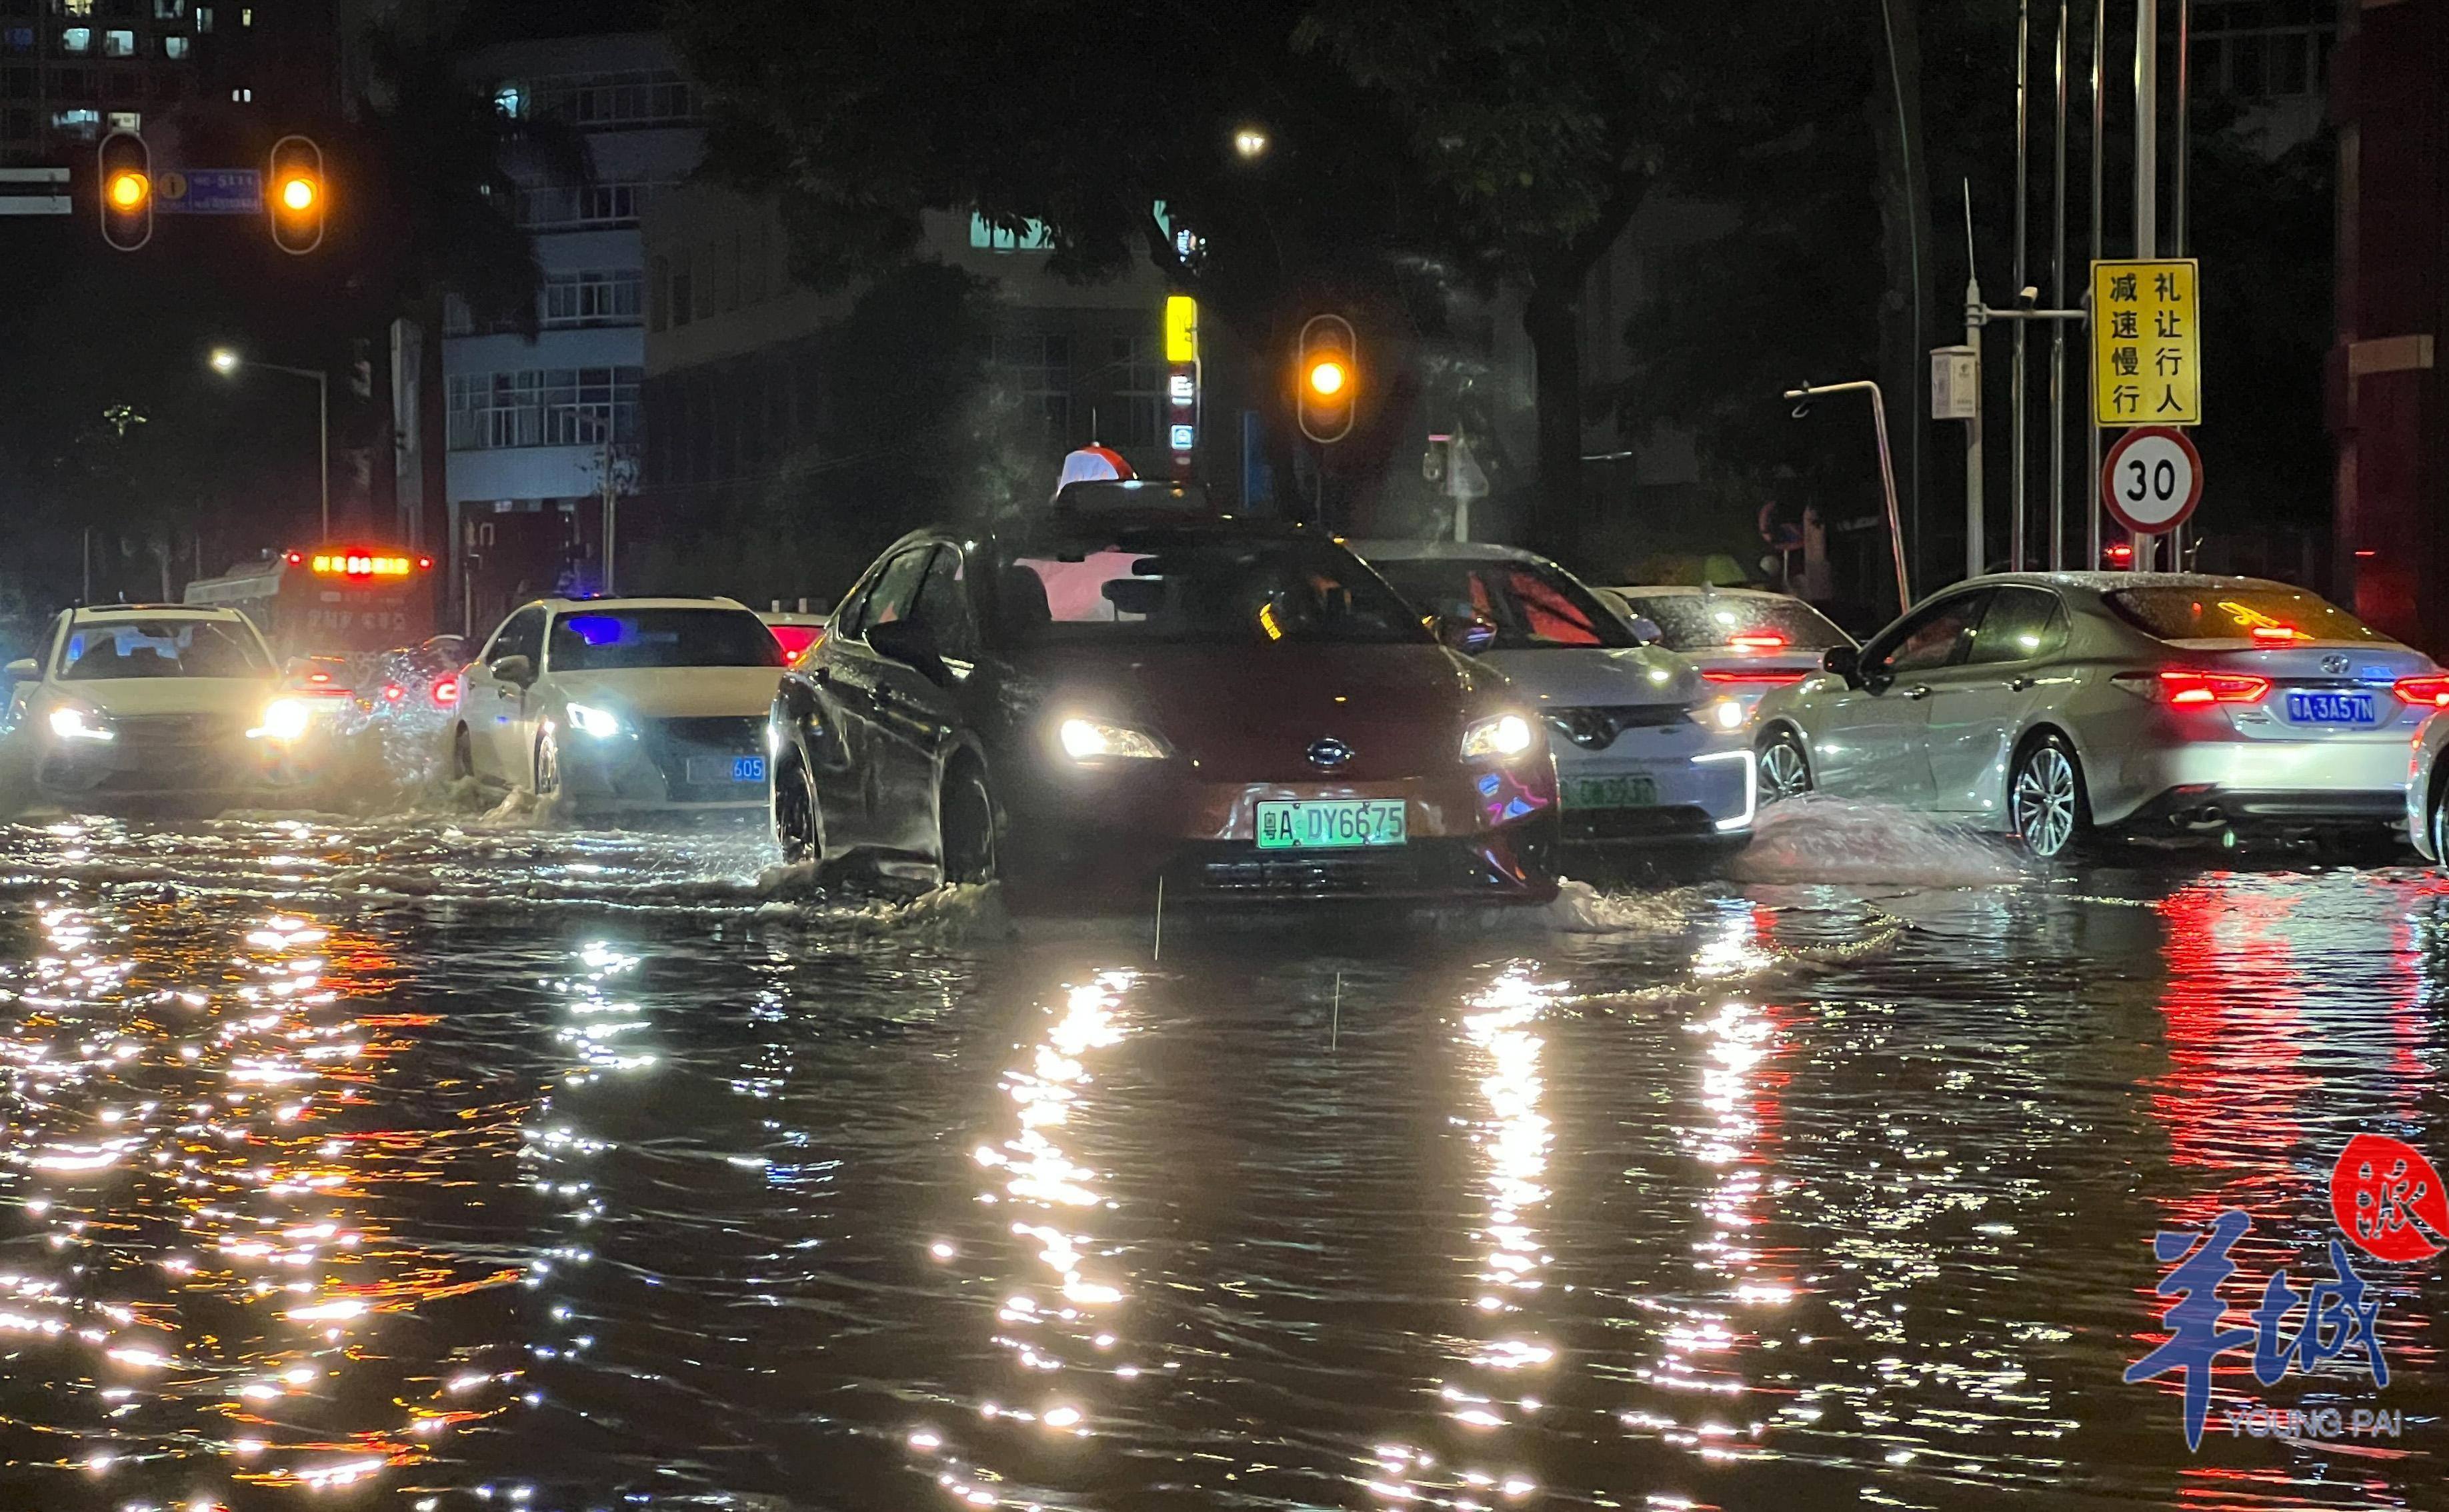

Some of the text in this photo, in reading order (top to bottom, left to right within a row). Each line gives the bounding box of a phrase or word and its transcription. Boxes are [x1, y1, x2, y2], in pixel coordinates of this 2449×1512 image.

[2110, 272, 2140, 414] 减速慢行
[2154, 271, 2183, 413] 礼让行人
[2126, 459, 2175, 502] 30
